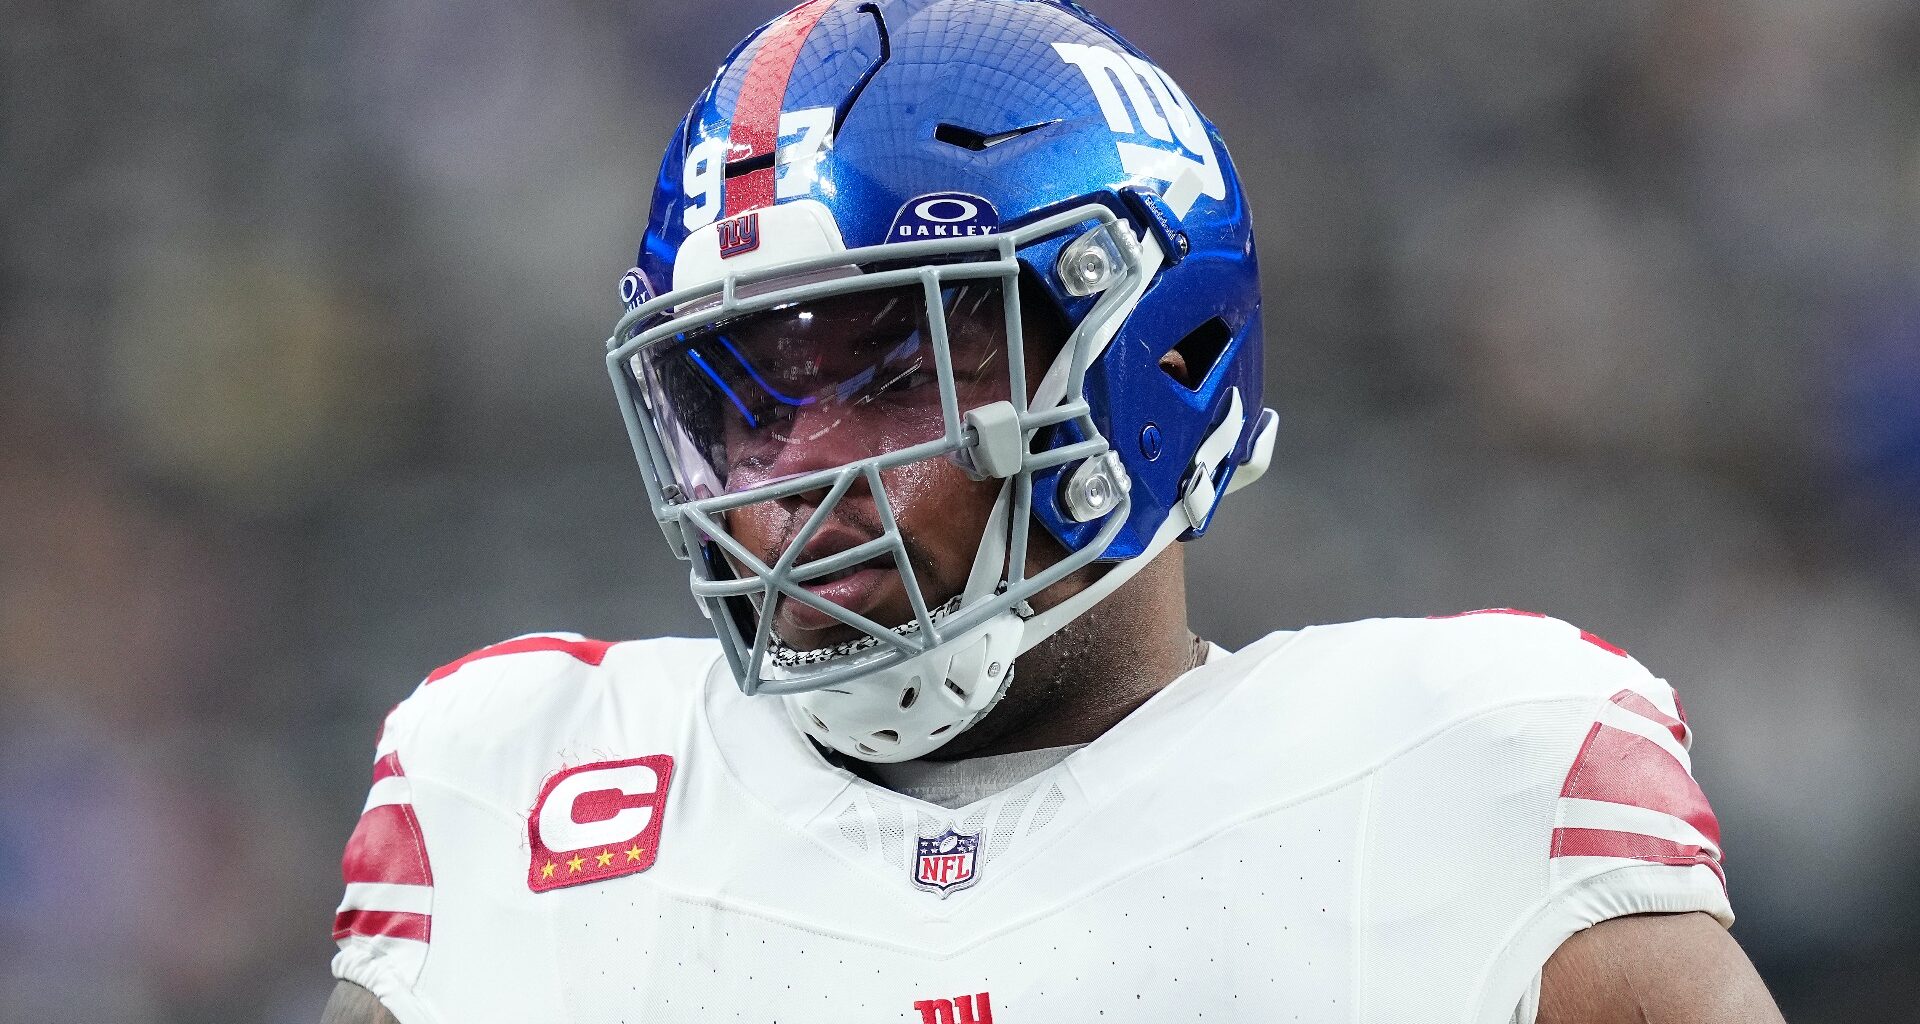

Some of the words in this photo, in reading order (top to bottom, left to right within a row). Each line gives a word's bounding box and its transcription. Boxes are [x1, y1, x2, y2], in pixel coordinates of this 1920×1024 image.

[900, 225, 992, 237] OAKLEY
[539, 765, 658, 853] C
[921, 855, 970, 883] NFL
